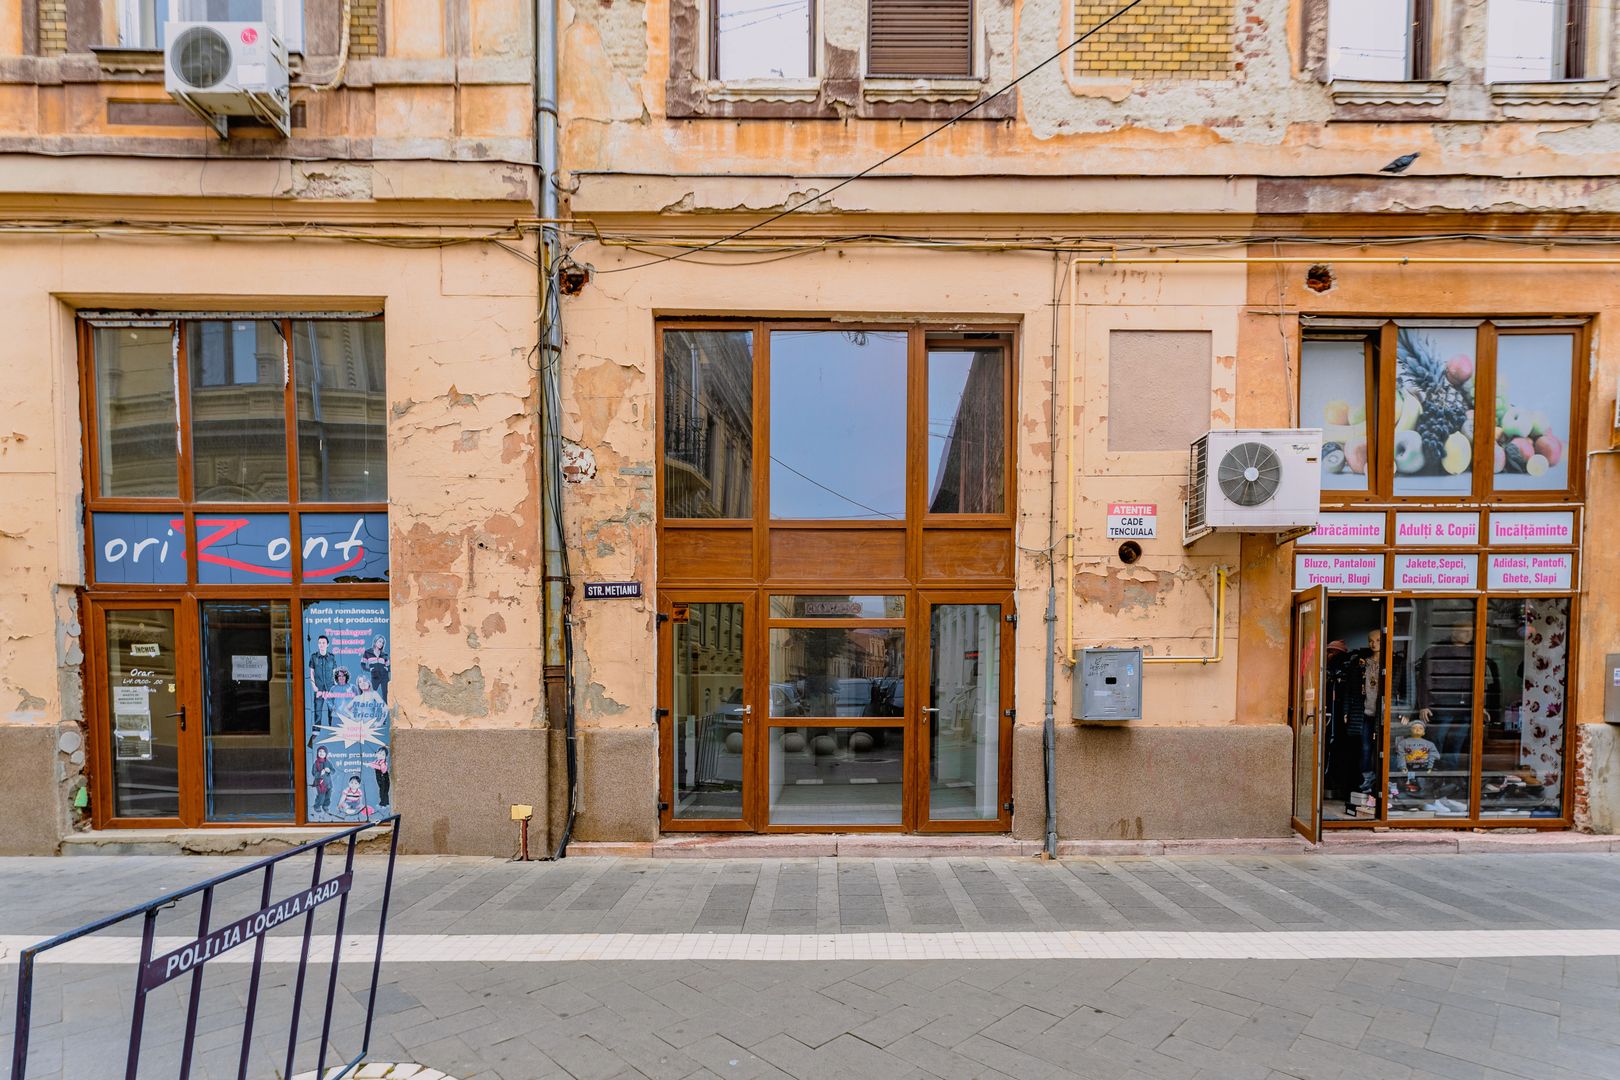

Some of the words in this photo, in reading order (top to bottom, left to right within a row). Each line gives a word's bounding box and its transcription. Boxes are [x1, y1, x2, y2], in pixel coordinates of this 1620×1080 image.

[1121, 518, 1143, 526] CADE
[1309, 524, 1380, 536] brăcăminte
[1399, 523, 1432, 539] Adulți
[1435, 524, 1444, 536] &
[1448, 523, 1476, 538] Copii
[1495, 521, 1568, 540] Încălțăminte
[1304, 558, 1331, 569] Bluze,
[1334, 558, 1376, 568] Pantaloni
[1493, 557, 1529, 569] Adidasi,
[1532, 557, 1567, 568] Pantofi,
[1309, 573, 1345, 584] Tricouri,
[1348, 573, 1370, 585] Blugi
[1402, 573, 1435, 584] Caciuli,
[1438, 573, 1469, 585] Ciorapi
[1503, 572, 1532, 584] Ghete,
[1535, 572, 1557, 584] Slapi
[245, 898, 300, 939] LOCALA
[304, 880, 339, 910] ARAD
